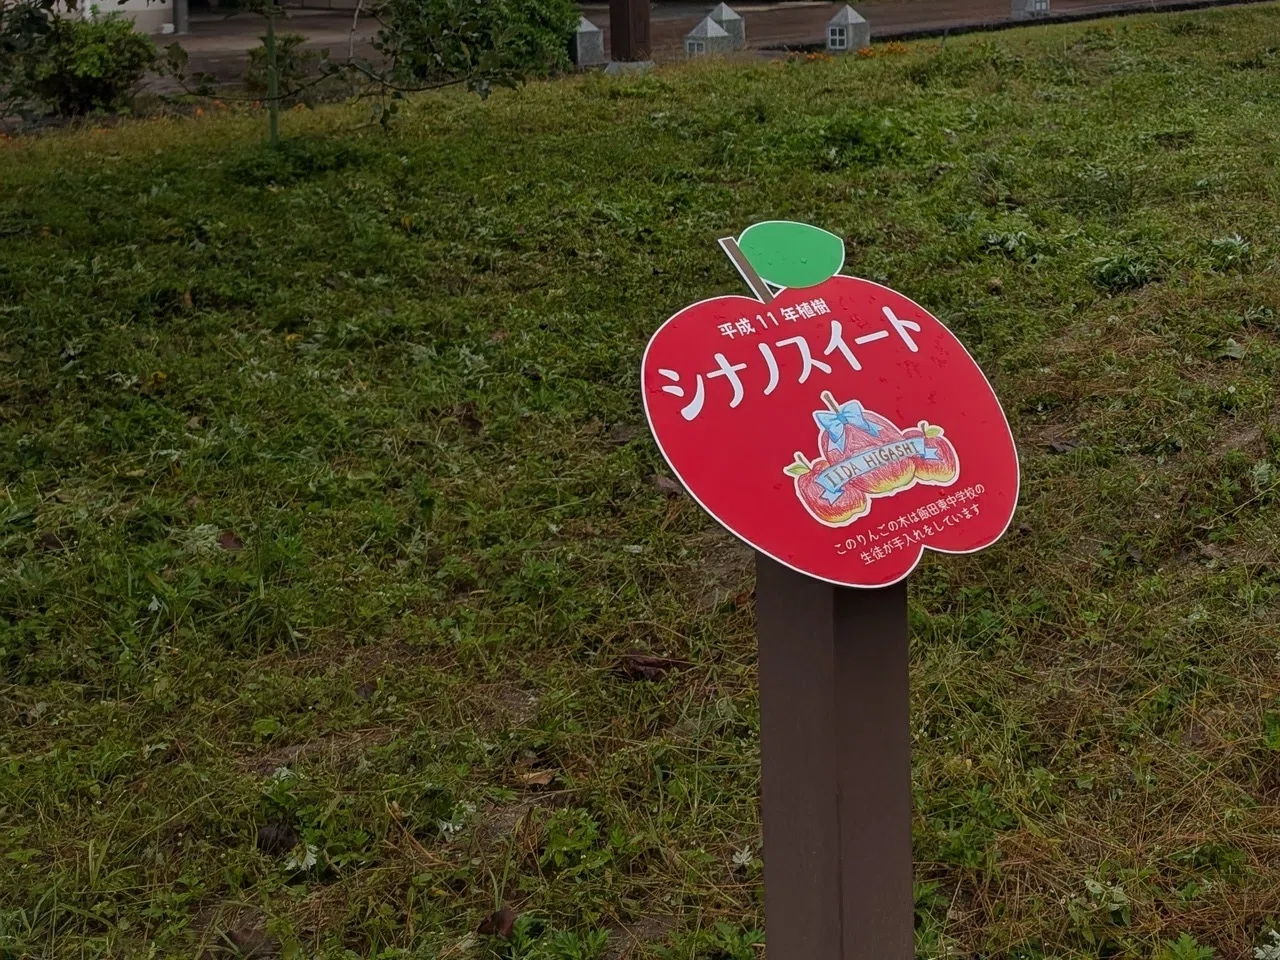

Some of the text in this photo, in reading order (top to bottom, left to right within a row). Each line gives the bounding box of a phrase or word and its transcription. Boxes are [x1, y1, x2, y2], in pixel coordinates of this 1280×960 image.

[658, 306, 921, 421] シナノスイート
[824, 441, 920, 487] IIDA HIGASHI
[834, 484, 985, 555] このりんごの木は飯田東中学校の
[860, 503, 981, 565] 生徒が手入れをしています
